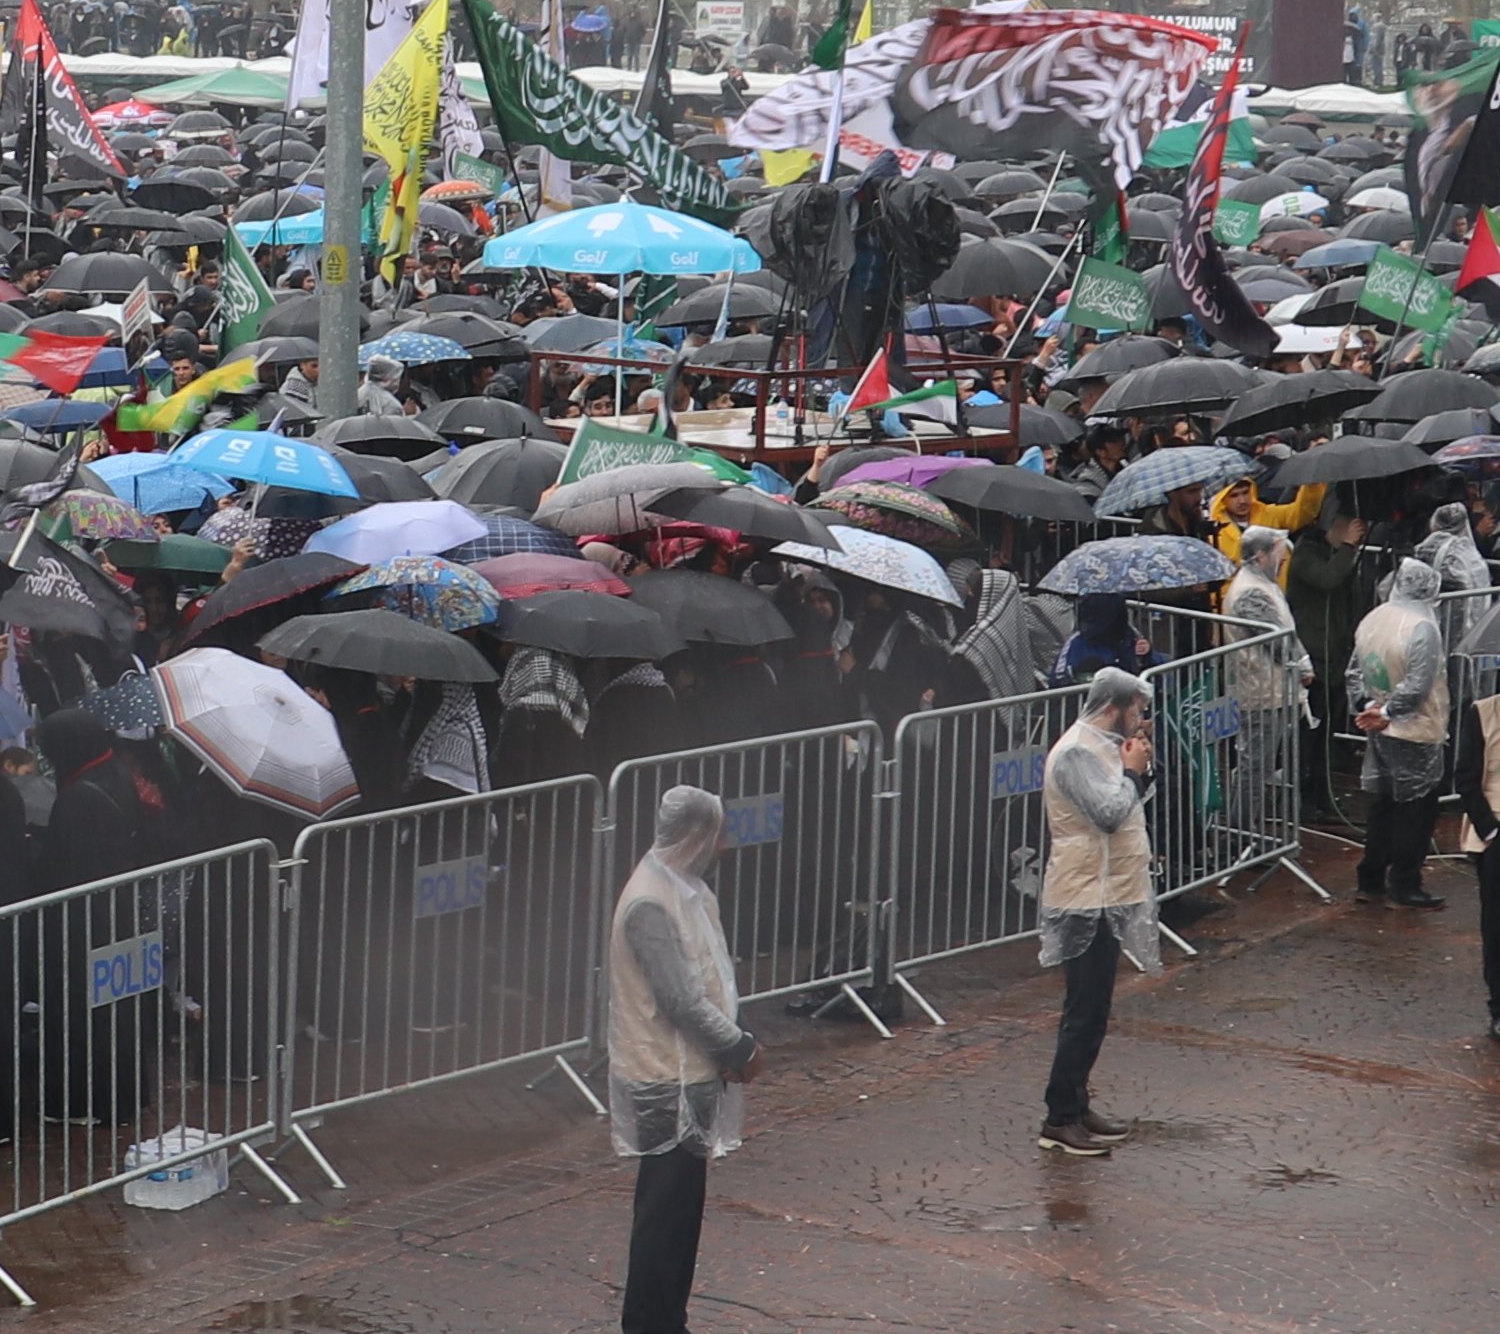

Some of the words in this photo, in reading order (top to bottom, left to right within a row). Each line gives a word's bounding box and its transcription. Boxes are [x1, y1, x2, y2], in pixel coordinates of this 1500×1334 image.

[574, 249, 608, 264] Golf
[670, 250, 699, 265] Golf
[1205, 699, 1241, 742] POLİS
[993, 747, 1044, 797] POLİS
[418, 860, 486, 915] POLİS
[93, 941, 163, 1004] POLİS
